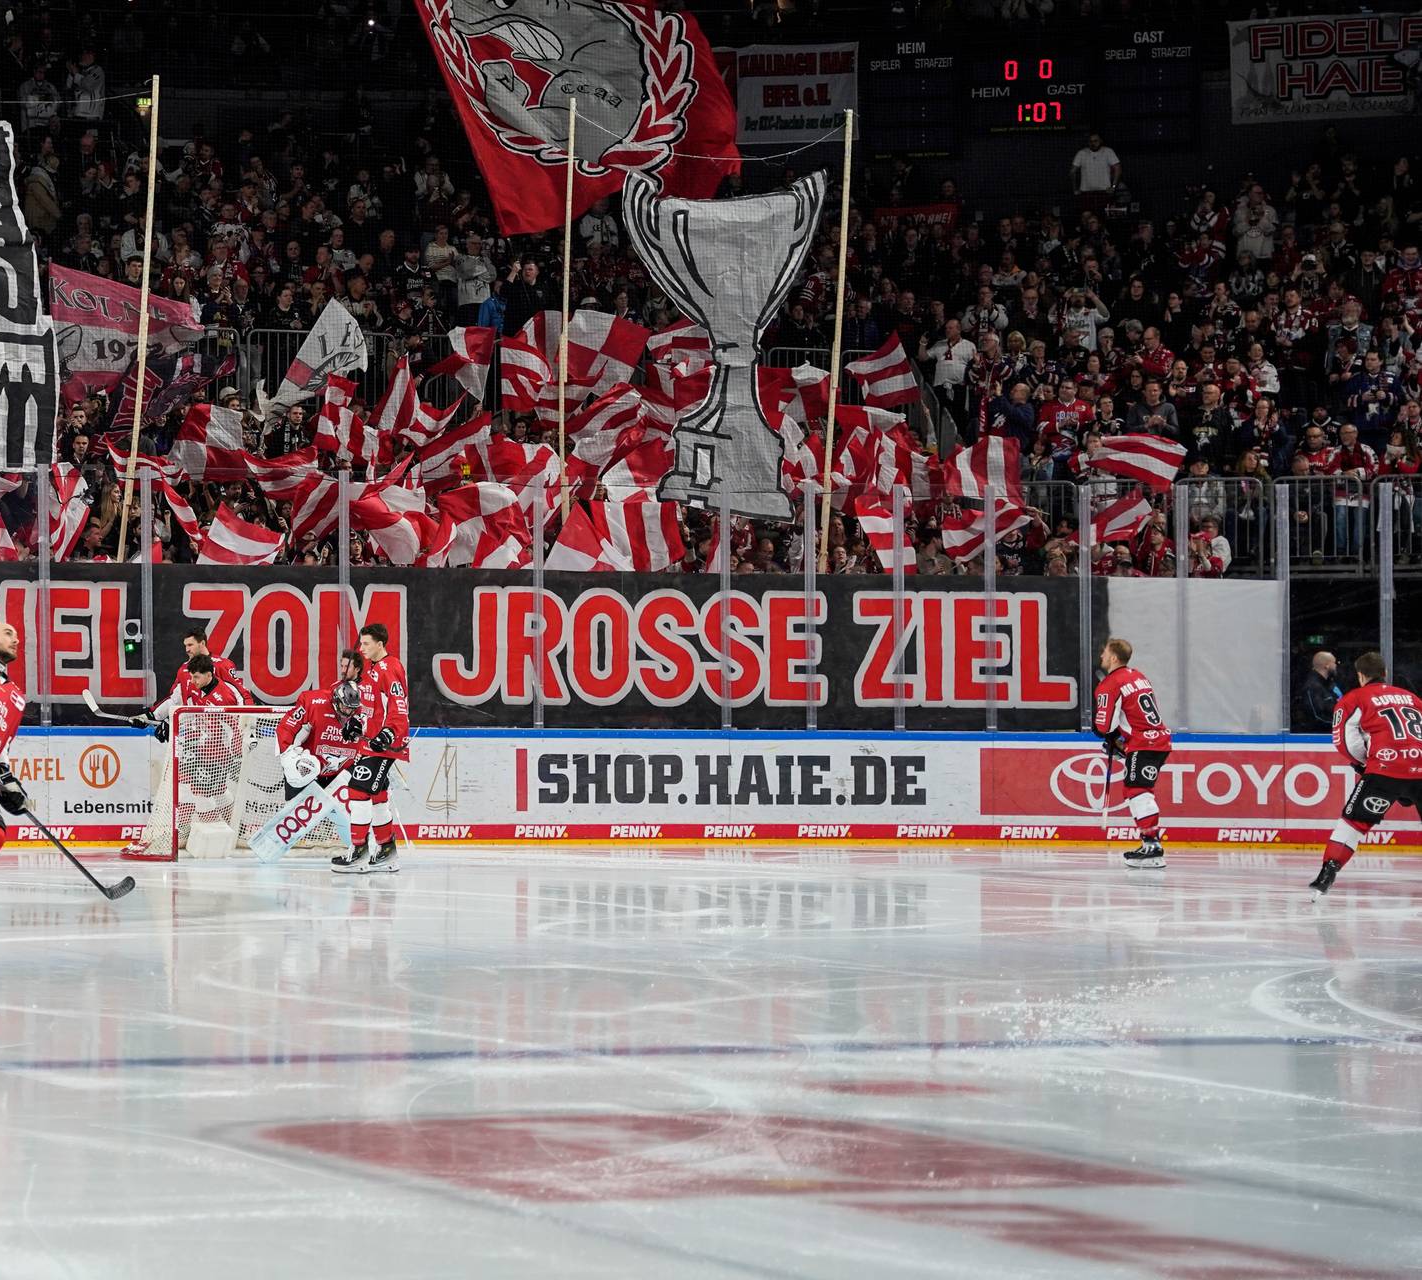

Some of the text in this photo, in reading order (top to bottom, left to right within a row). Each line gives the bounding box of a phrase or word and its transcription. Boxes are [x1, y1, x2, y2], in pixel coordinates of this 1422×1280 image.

[1134, 31, 1165, 43] GAST
[897, 42, 926, 54] HEIM
[1105, 46, 1192, 60] SPIELER STRAFZEIT
[870, 57, 954, 71] SPIELER STRAFZEIT
[1004, 59, 1053, 80] 0 0
[1277, 59, 1404, 99] HAIE
[971, 84, 1086, 98] HEIM GAST
[1017, 102, 1061, 122] 1:07
[433, 585, 828, 708] JROSSE
[853, 591, 1077, 709] ZIEL
[1371, 694, 1414, 706] CURRIE
[1379, 706, 1422, 740] 18
[326, 725, 344, 736] Rhe
[1400, 748, 1422, 759] TOY
[537, 753, 927, 806] SHOP.HAIE.DE
[1159, 763, 1361, 808] TOYOT
[64, 800, 154, 814] Lebensmit
